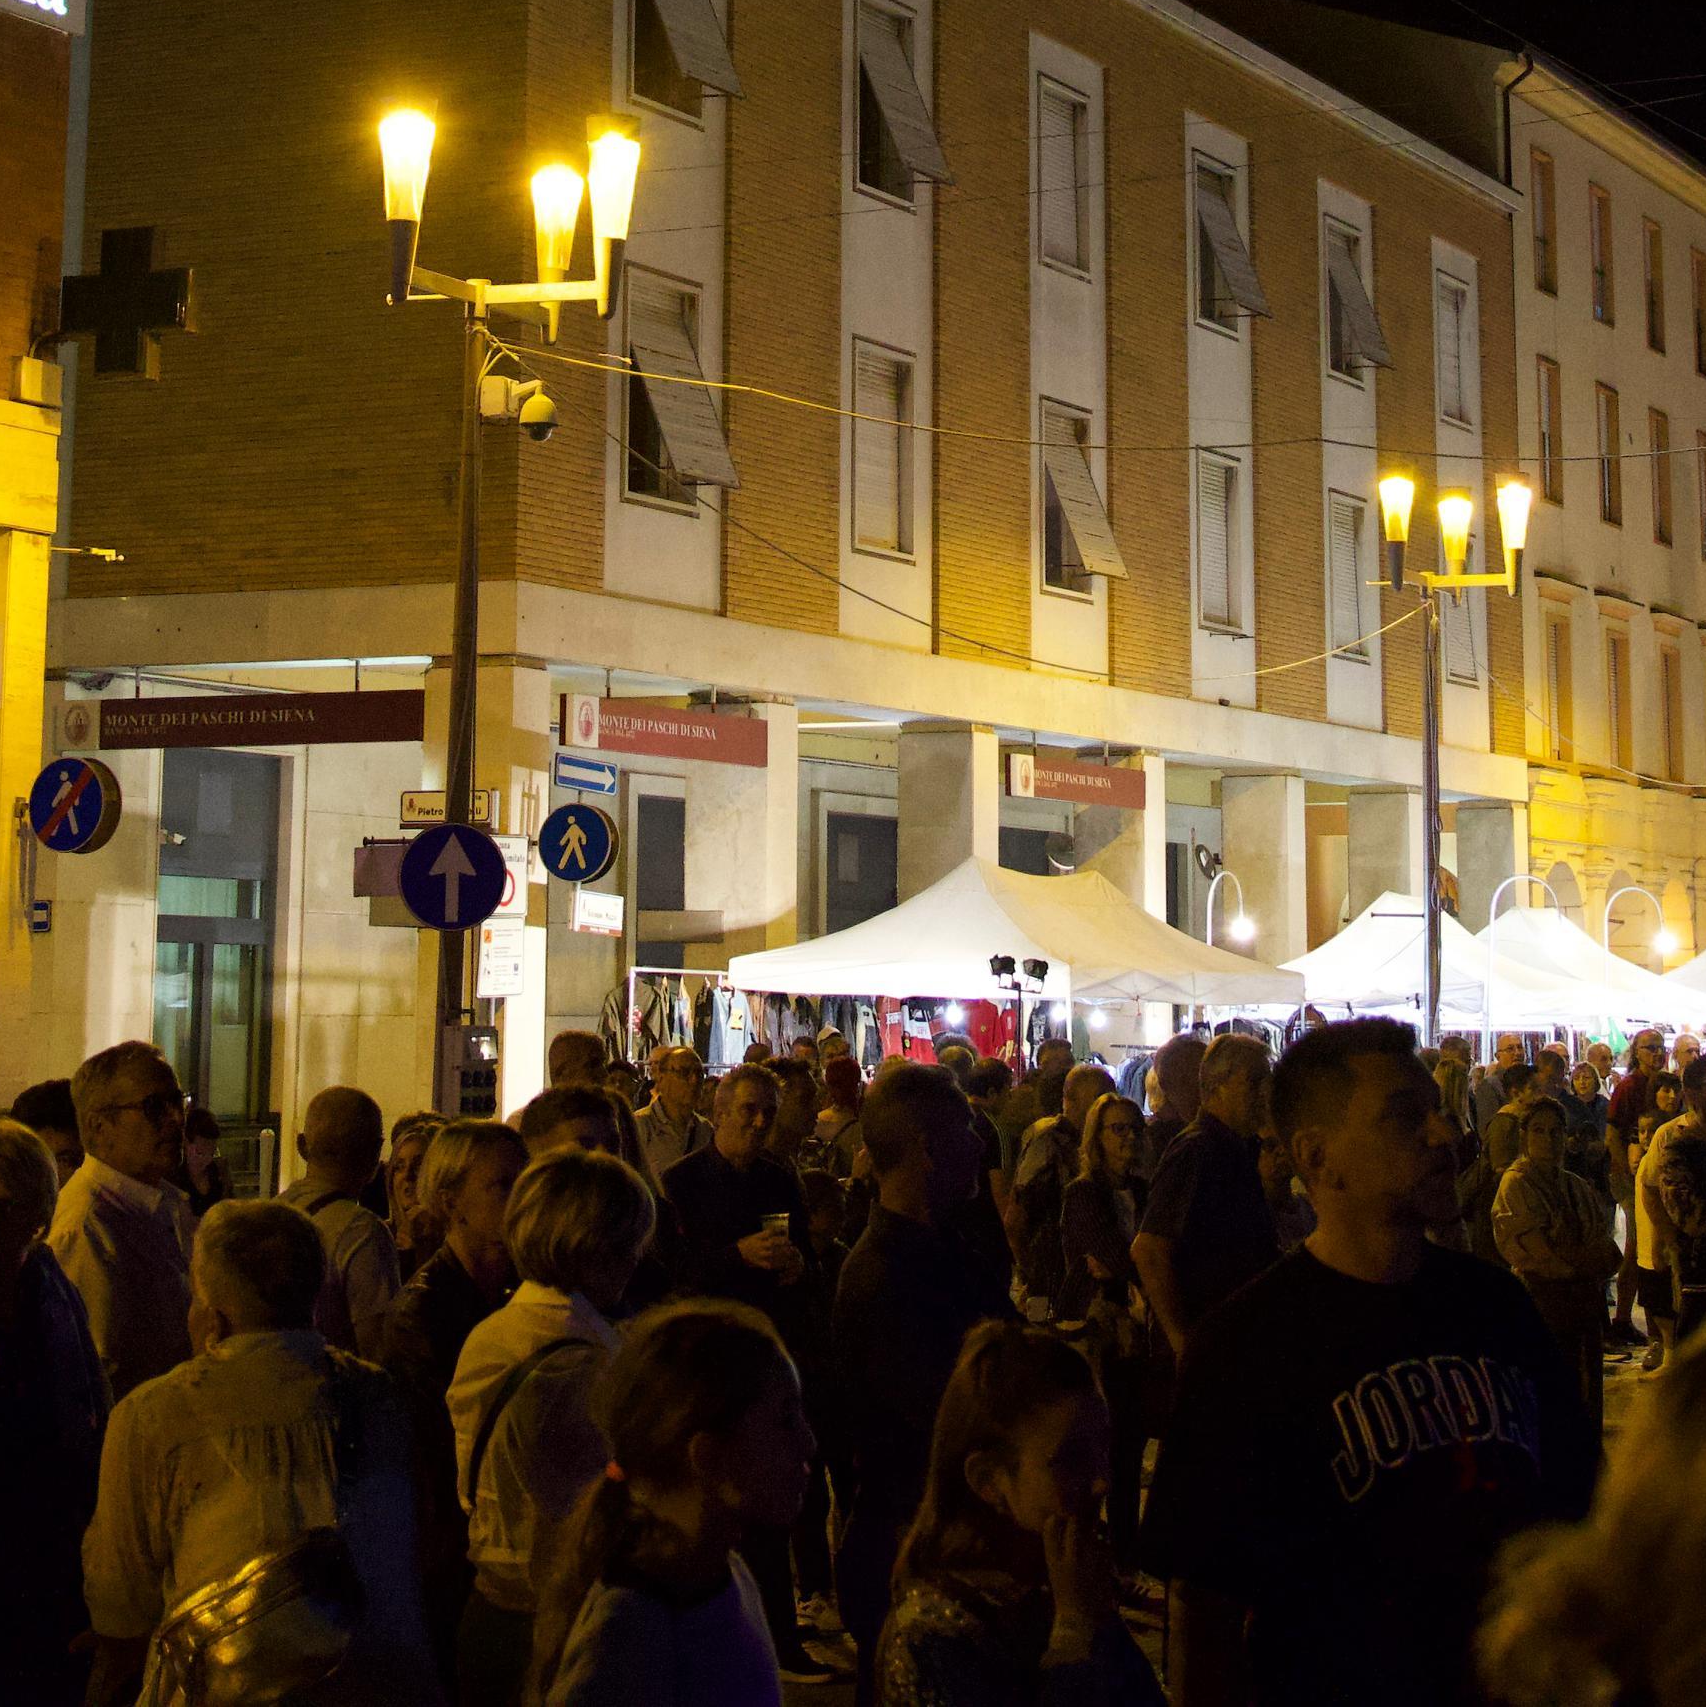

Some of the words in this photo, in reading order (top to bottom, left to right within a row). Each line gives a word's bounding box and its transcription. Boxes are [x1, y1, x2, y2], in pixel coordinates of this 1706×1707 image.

[104, 712, 155, 728] MONTE
[159, 711, 188, 726] DEI
[190, 709, 245, 726] PASCHI
[249, 709, 267, 724] DI
[269, 707, 316, 723] SIENA
[599, 714, 631, 730] MONTE
[631, 718, 646, 732] DEI
[648, 720, 678, 736] PASCHI
[680, 723, 691, 737] DI
[691, 725, 717, 740] SIENA
[417, 807, 444, 816] Pietro
[1331, 1353, 1542, 1504] JORDA
